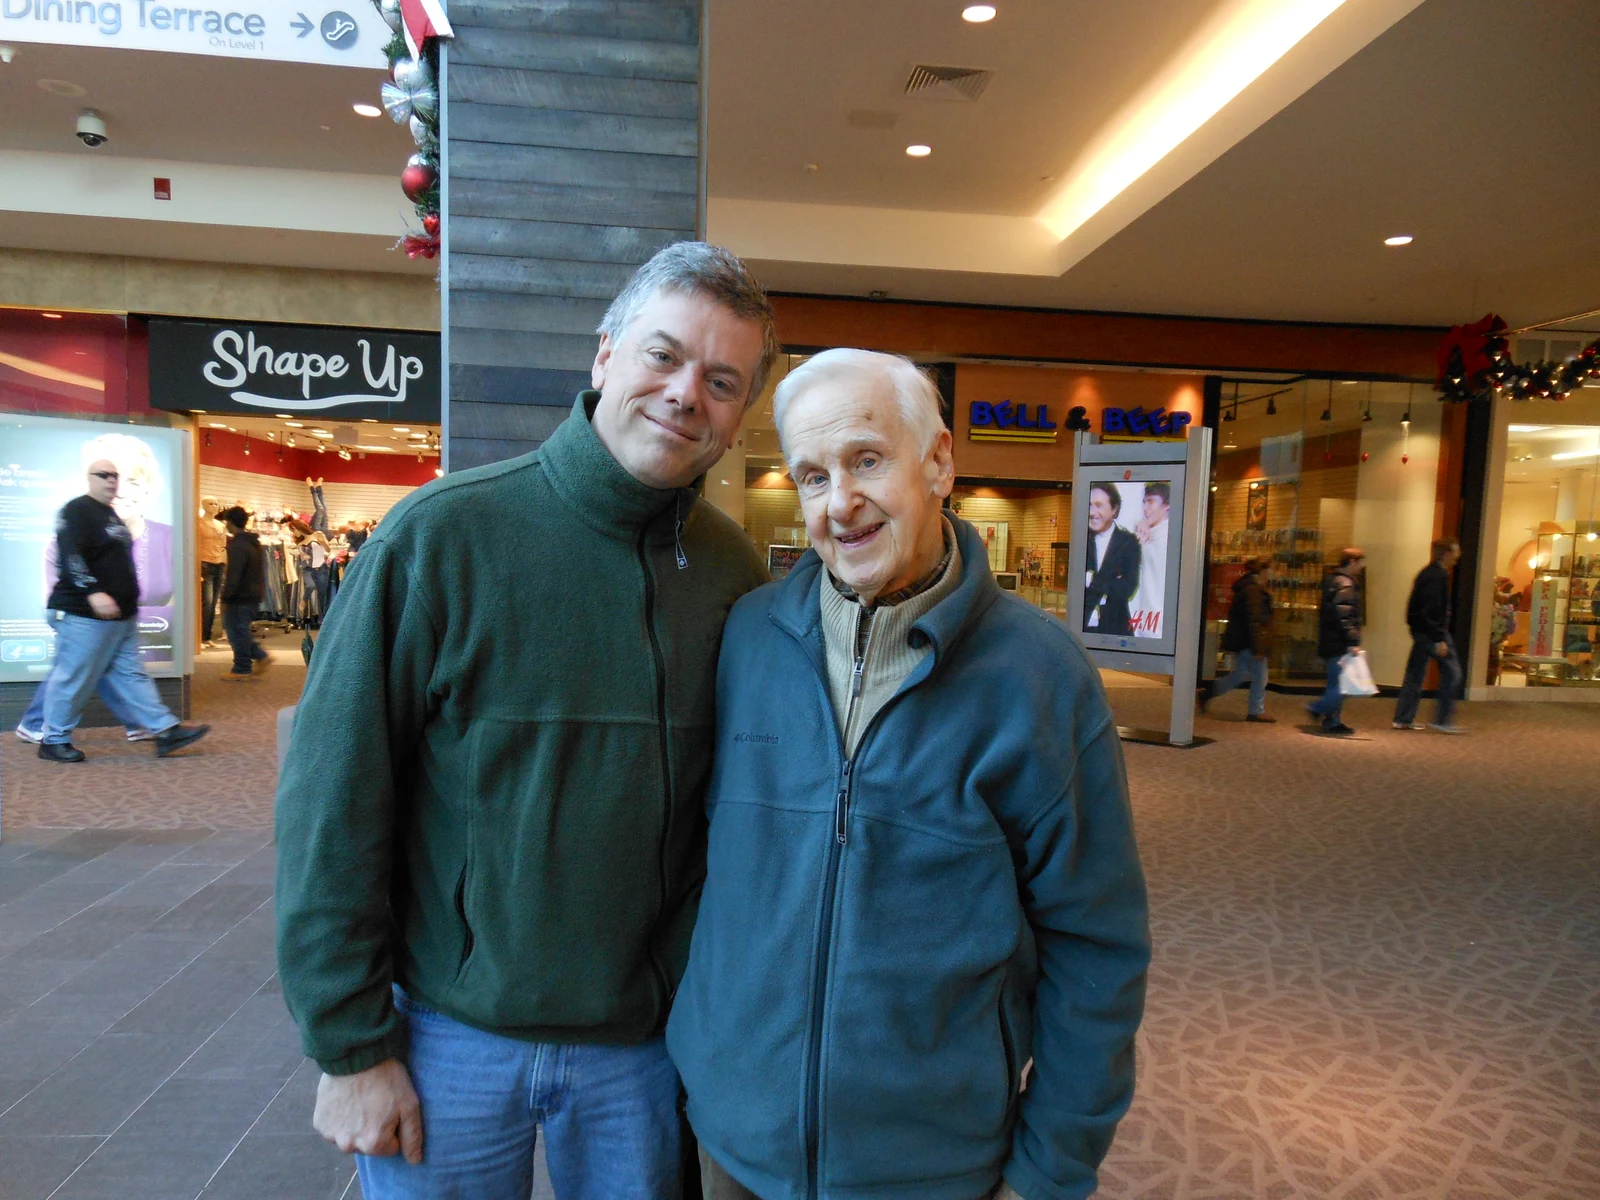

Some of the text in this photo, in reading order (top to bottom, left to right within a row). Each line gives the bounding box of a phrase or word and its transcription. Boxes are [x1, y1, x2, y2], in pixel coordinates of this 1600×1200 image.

[3, 0, 266, 36] Dining Terrace
[209, 37, 265, 51] On Level 1
[203, 330, 423, 402] Shape Up
[970, 399, 1192, 435] BELL & BEEP
[1127, 610, 1160, 633] H&M
[740, 732, 779, 744] Columbia
